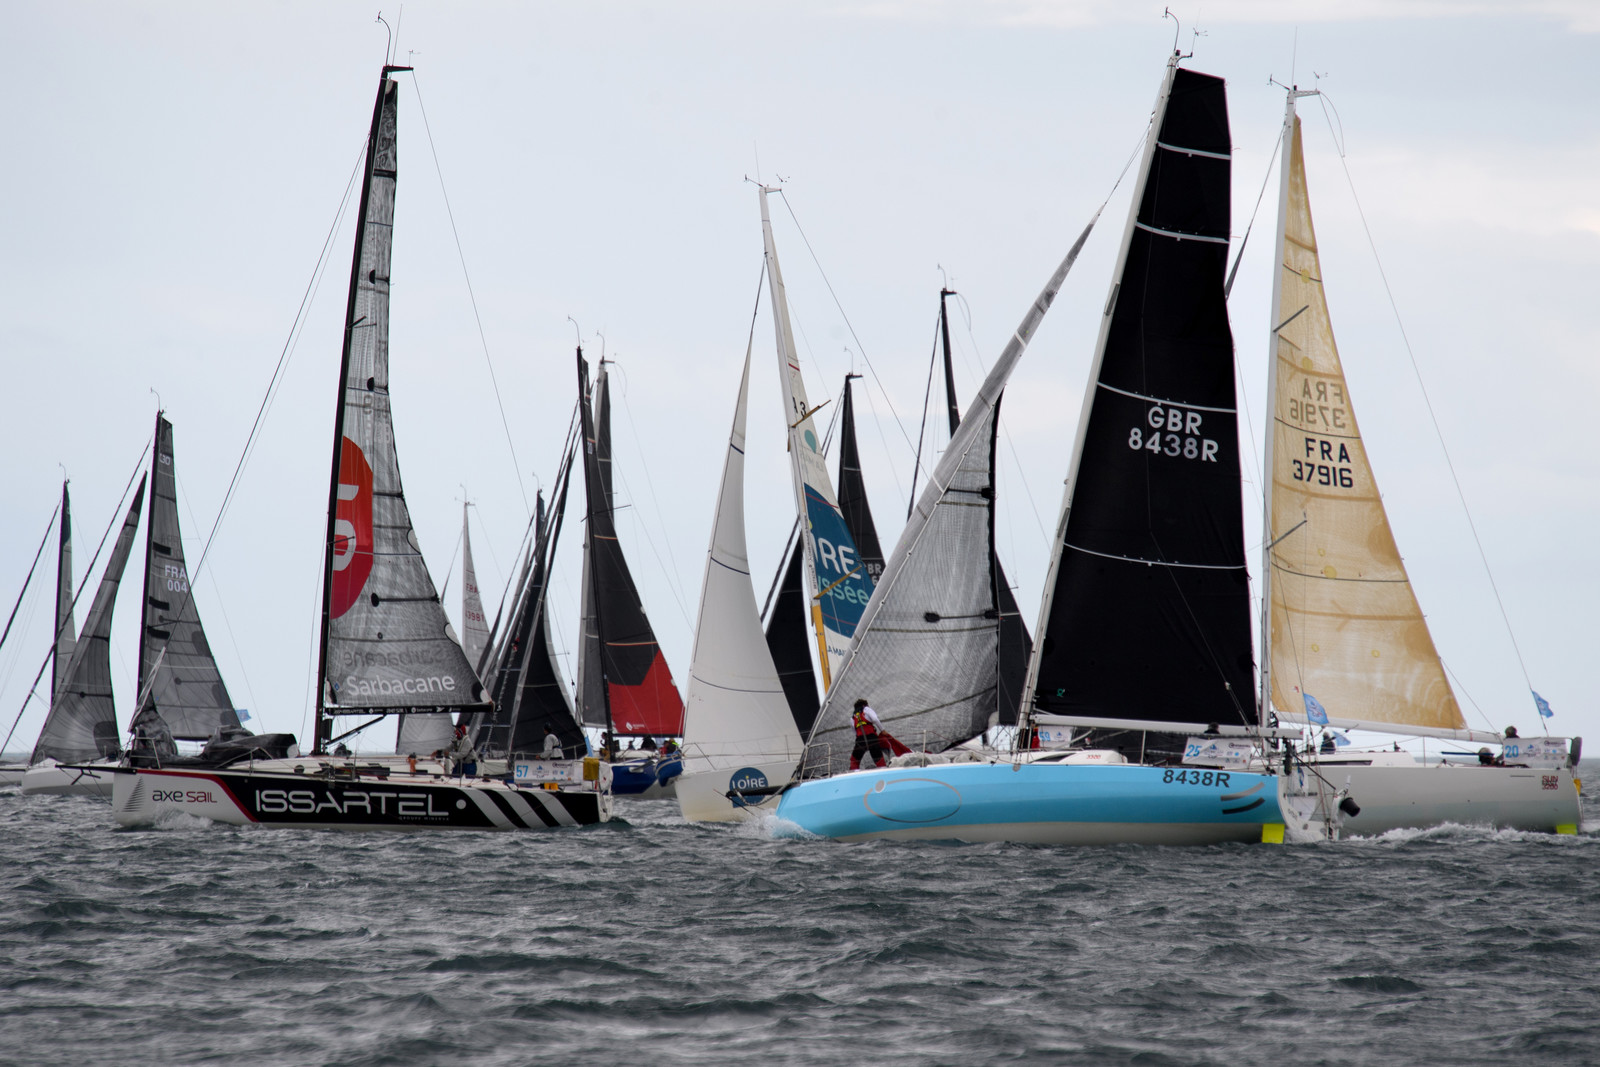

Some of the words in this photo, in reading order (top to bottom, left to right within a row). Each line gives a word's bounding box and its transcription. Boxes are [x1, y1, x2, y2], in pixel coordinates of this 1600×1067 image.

[1148, 406, 1202, 436] GBR
[1128, 427, 1219, 462] 8438R
[1305, 437, 1351, 463] FRA
[1293, 459, 1353, 488] 37916
[164, 564, 187, 580] FRA
[864, 562, 882, 574] BR
[167, 579, 188, 594] 004
[346, 675, 456, 696] Sarbacane
[1185, 744, 1202, 757] 25
[1504, 745, 1519, 758] 20
[516, 765, 529, 778] 57
[1162, 769, 1231, 788] 8438R
[152, 790, 184, 803] axe
[256, 789, 449, 816] ISSARTEL
